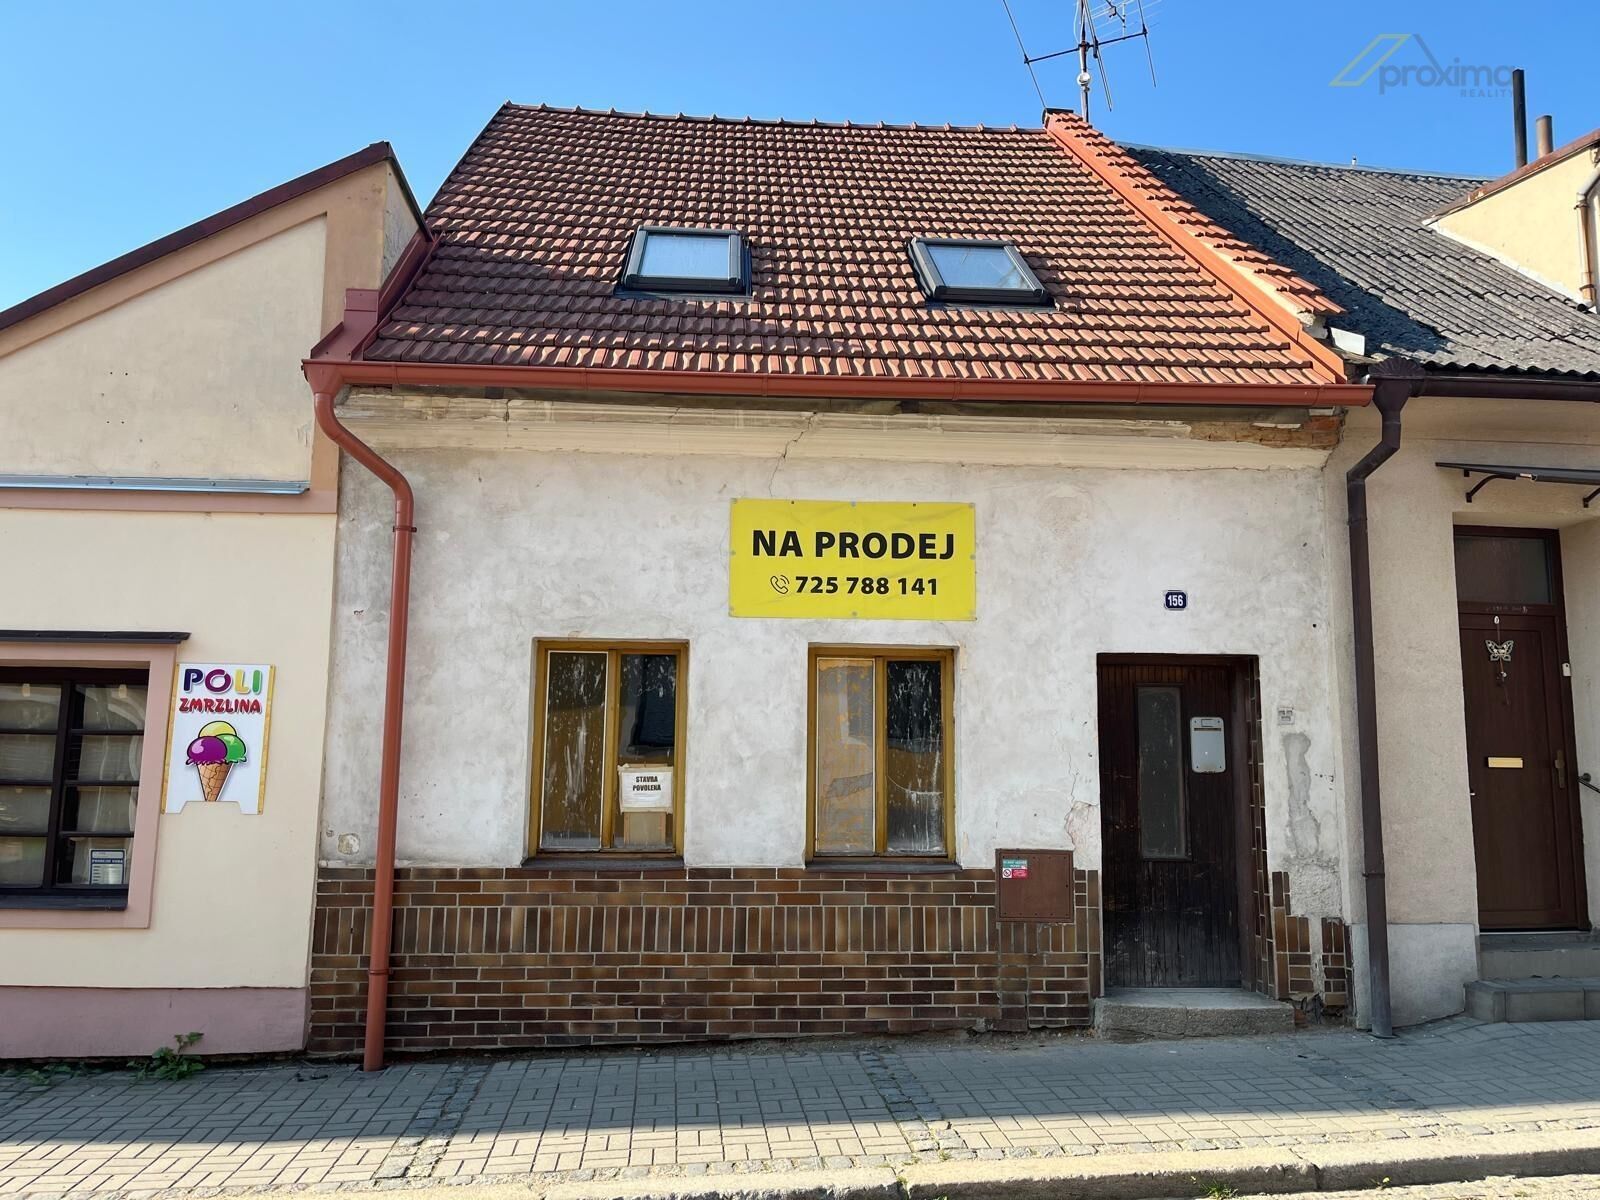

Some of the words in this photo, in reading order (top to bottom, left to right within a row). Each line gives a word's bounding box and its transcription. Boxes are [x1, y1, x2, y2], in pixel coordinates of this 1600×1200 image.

[752, 530, 803, 557] NA
[815, 532, 954, 560] PRODEJ
[795, 576, 838, 594] 725
[846, 577, 889, 595] 788
[897, 578, 937, 595] 141
[1167, 595, 1183, 606] 156
[183, 668, 263, 694] POLI
[179, 697, 262, 714] ZMRZLINA
